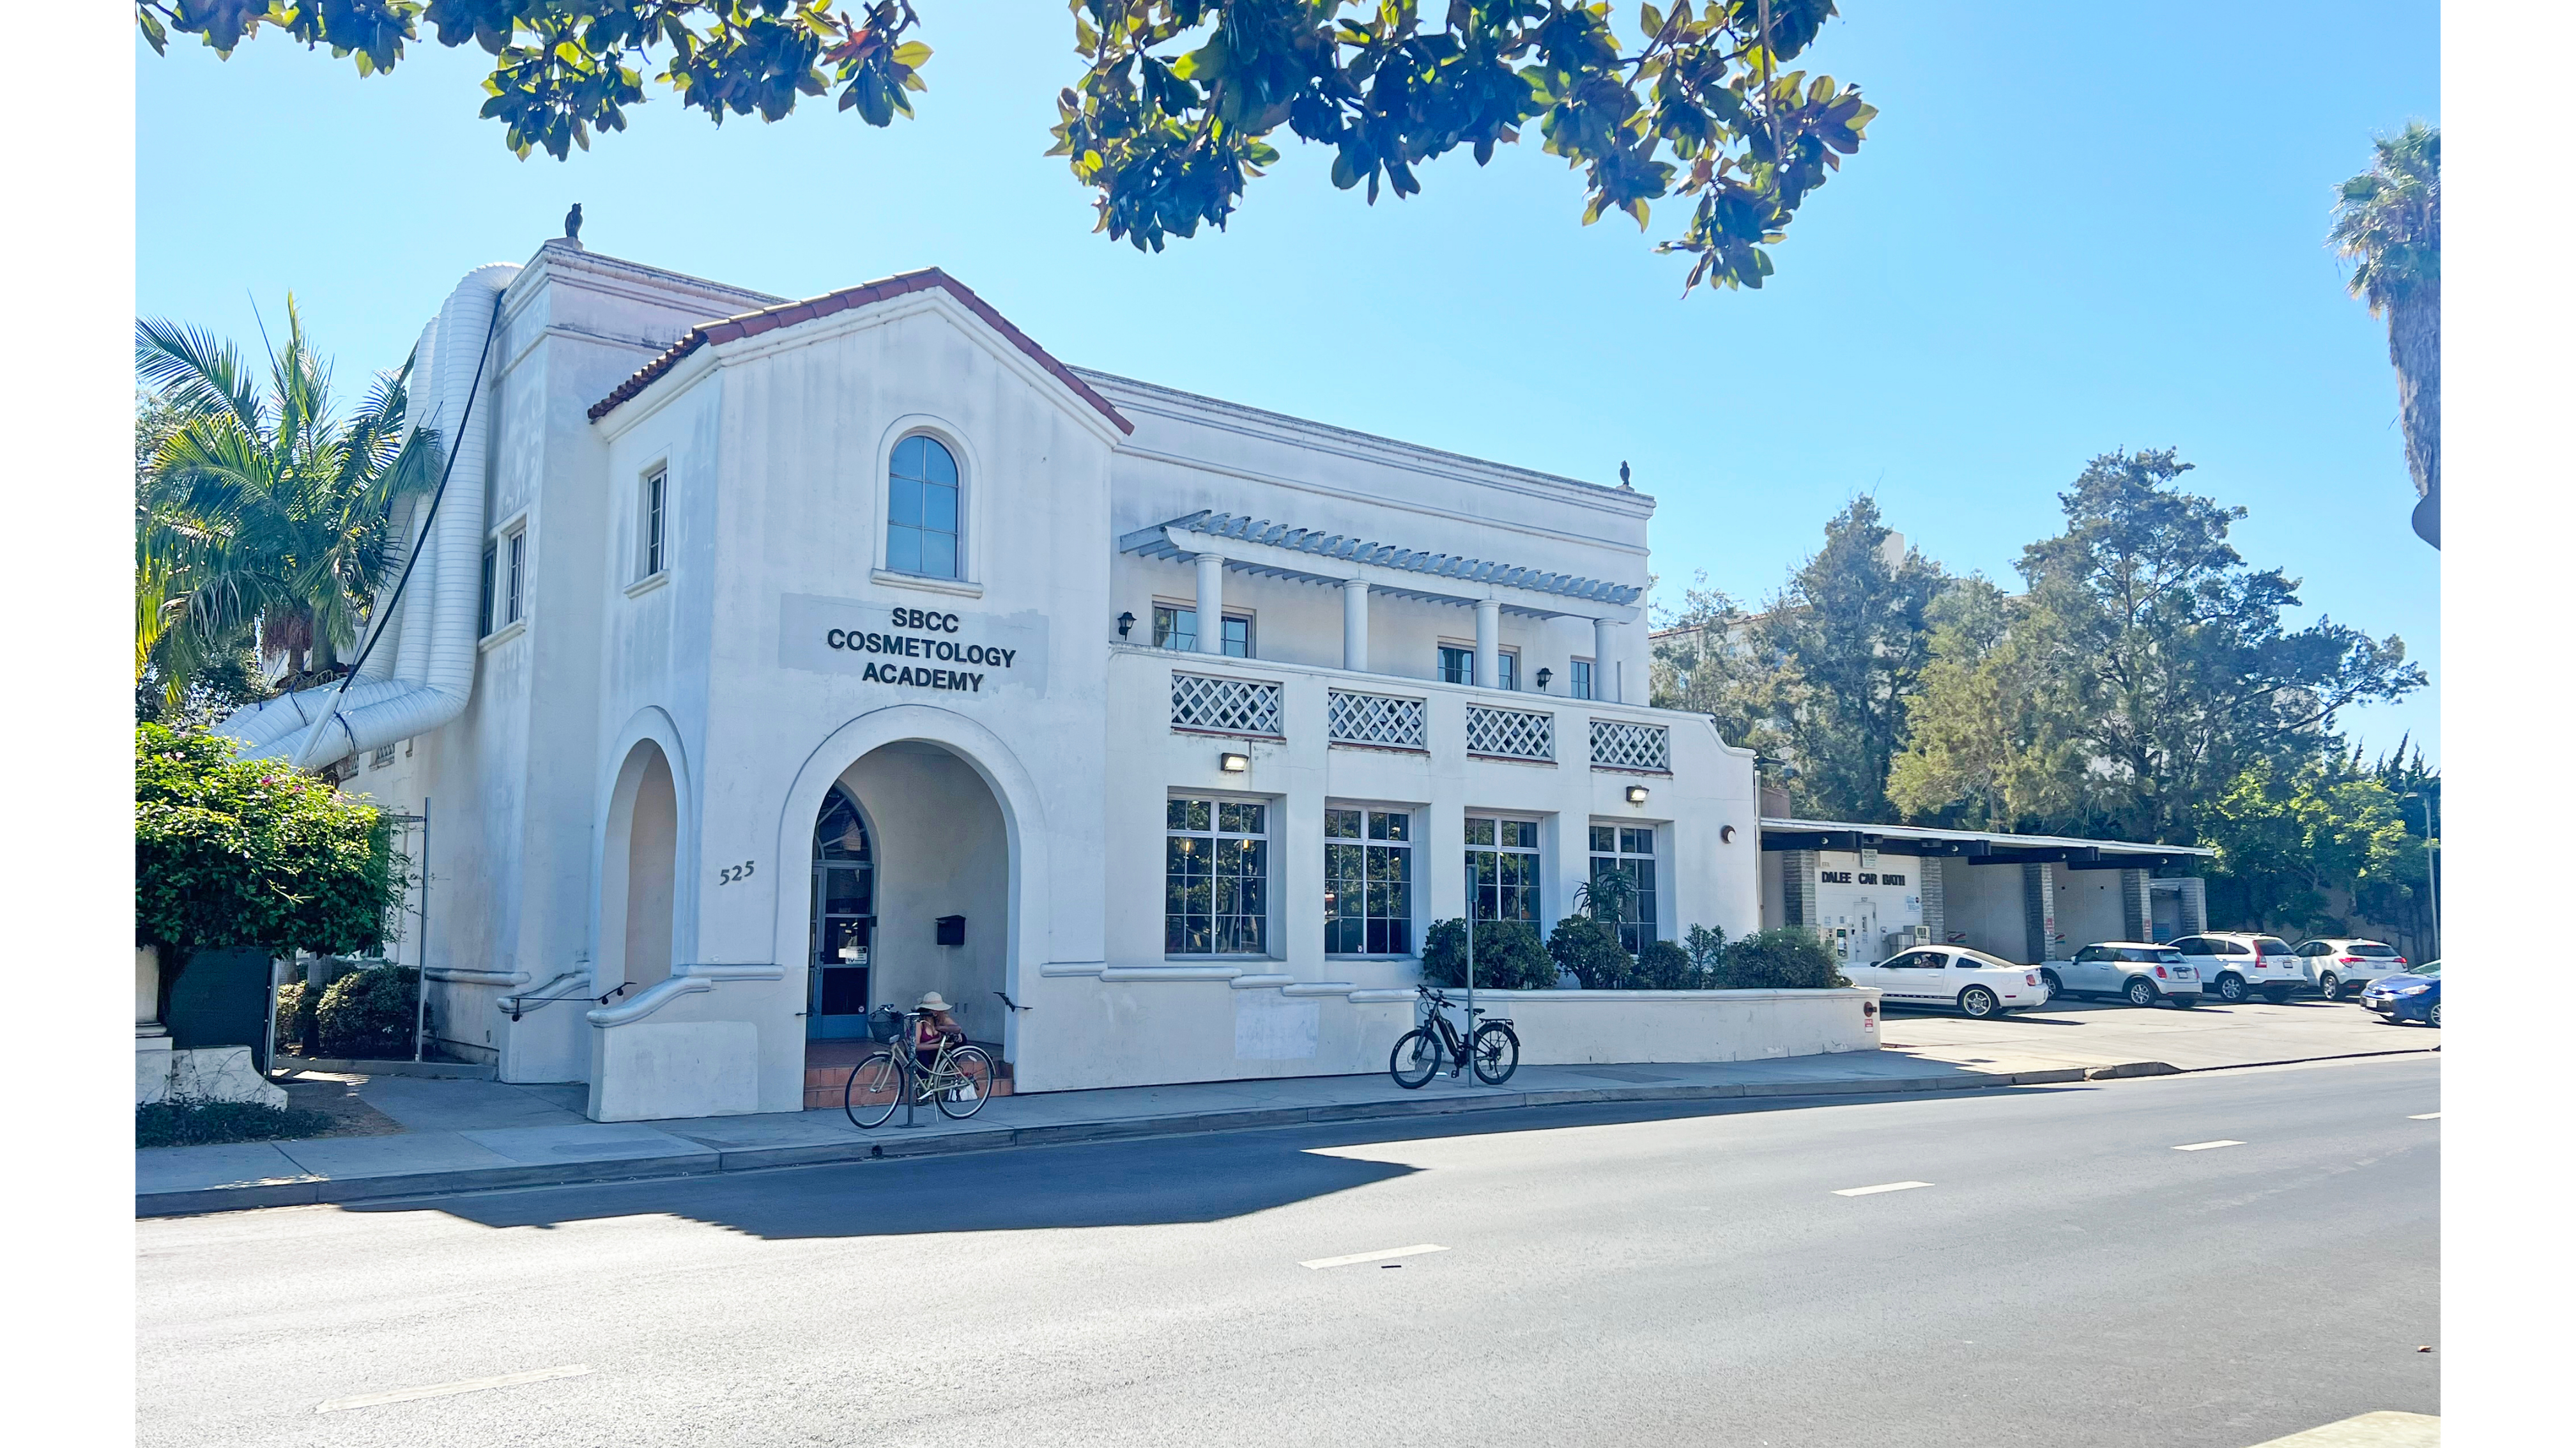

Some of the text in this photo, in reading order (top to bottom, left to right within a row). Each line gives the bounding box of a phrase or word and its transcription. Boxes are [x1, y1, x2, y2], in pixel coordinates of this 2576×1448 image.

[892, 607, 960, 633] SBCC
[827, 629, 1016, 668] COSMETOLOGY
[862, 662, 984, 692] ACADEMY
[719, 860, 755, 886] 525
[1821, 871, 1906, 886] DALEE CAR BATH
